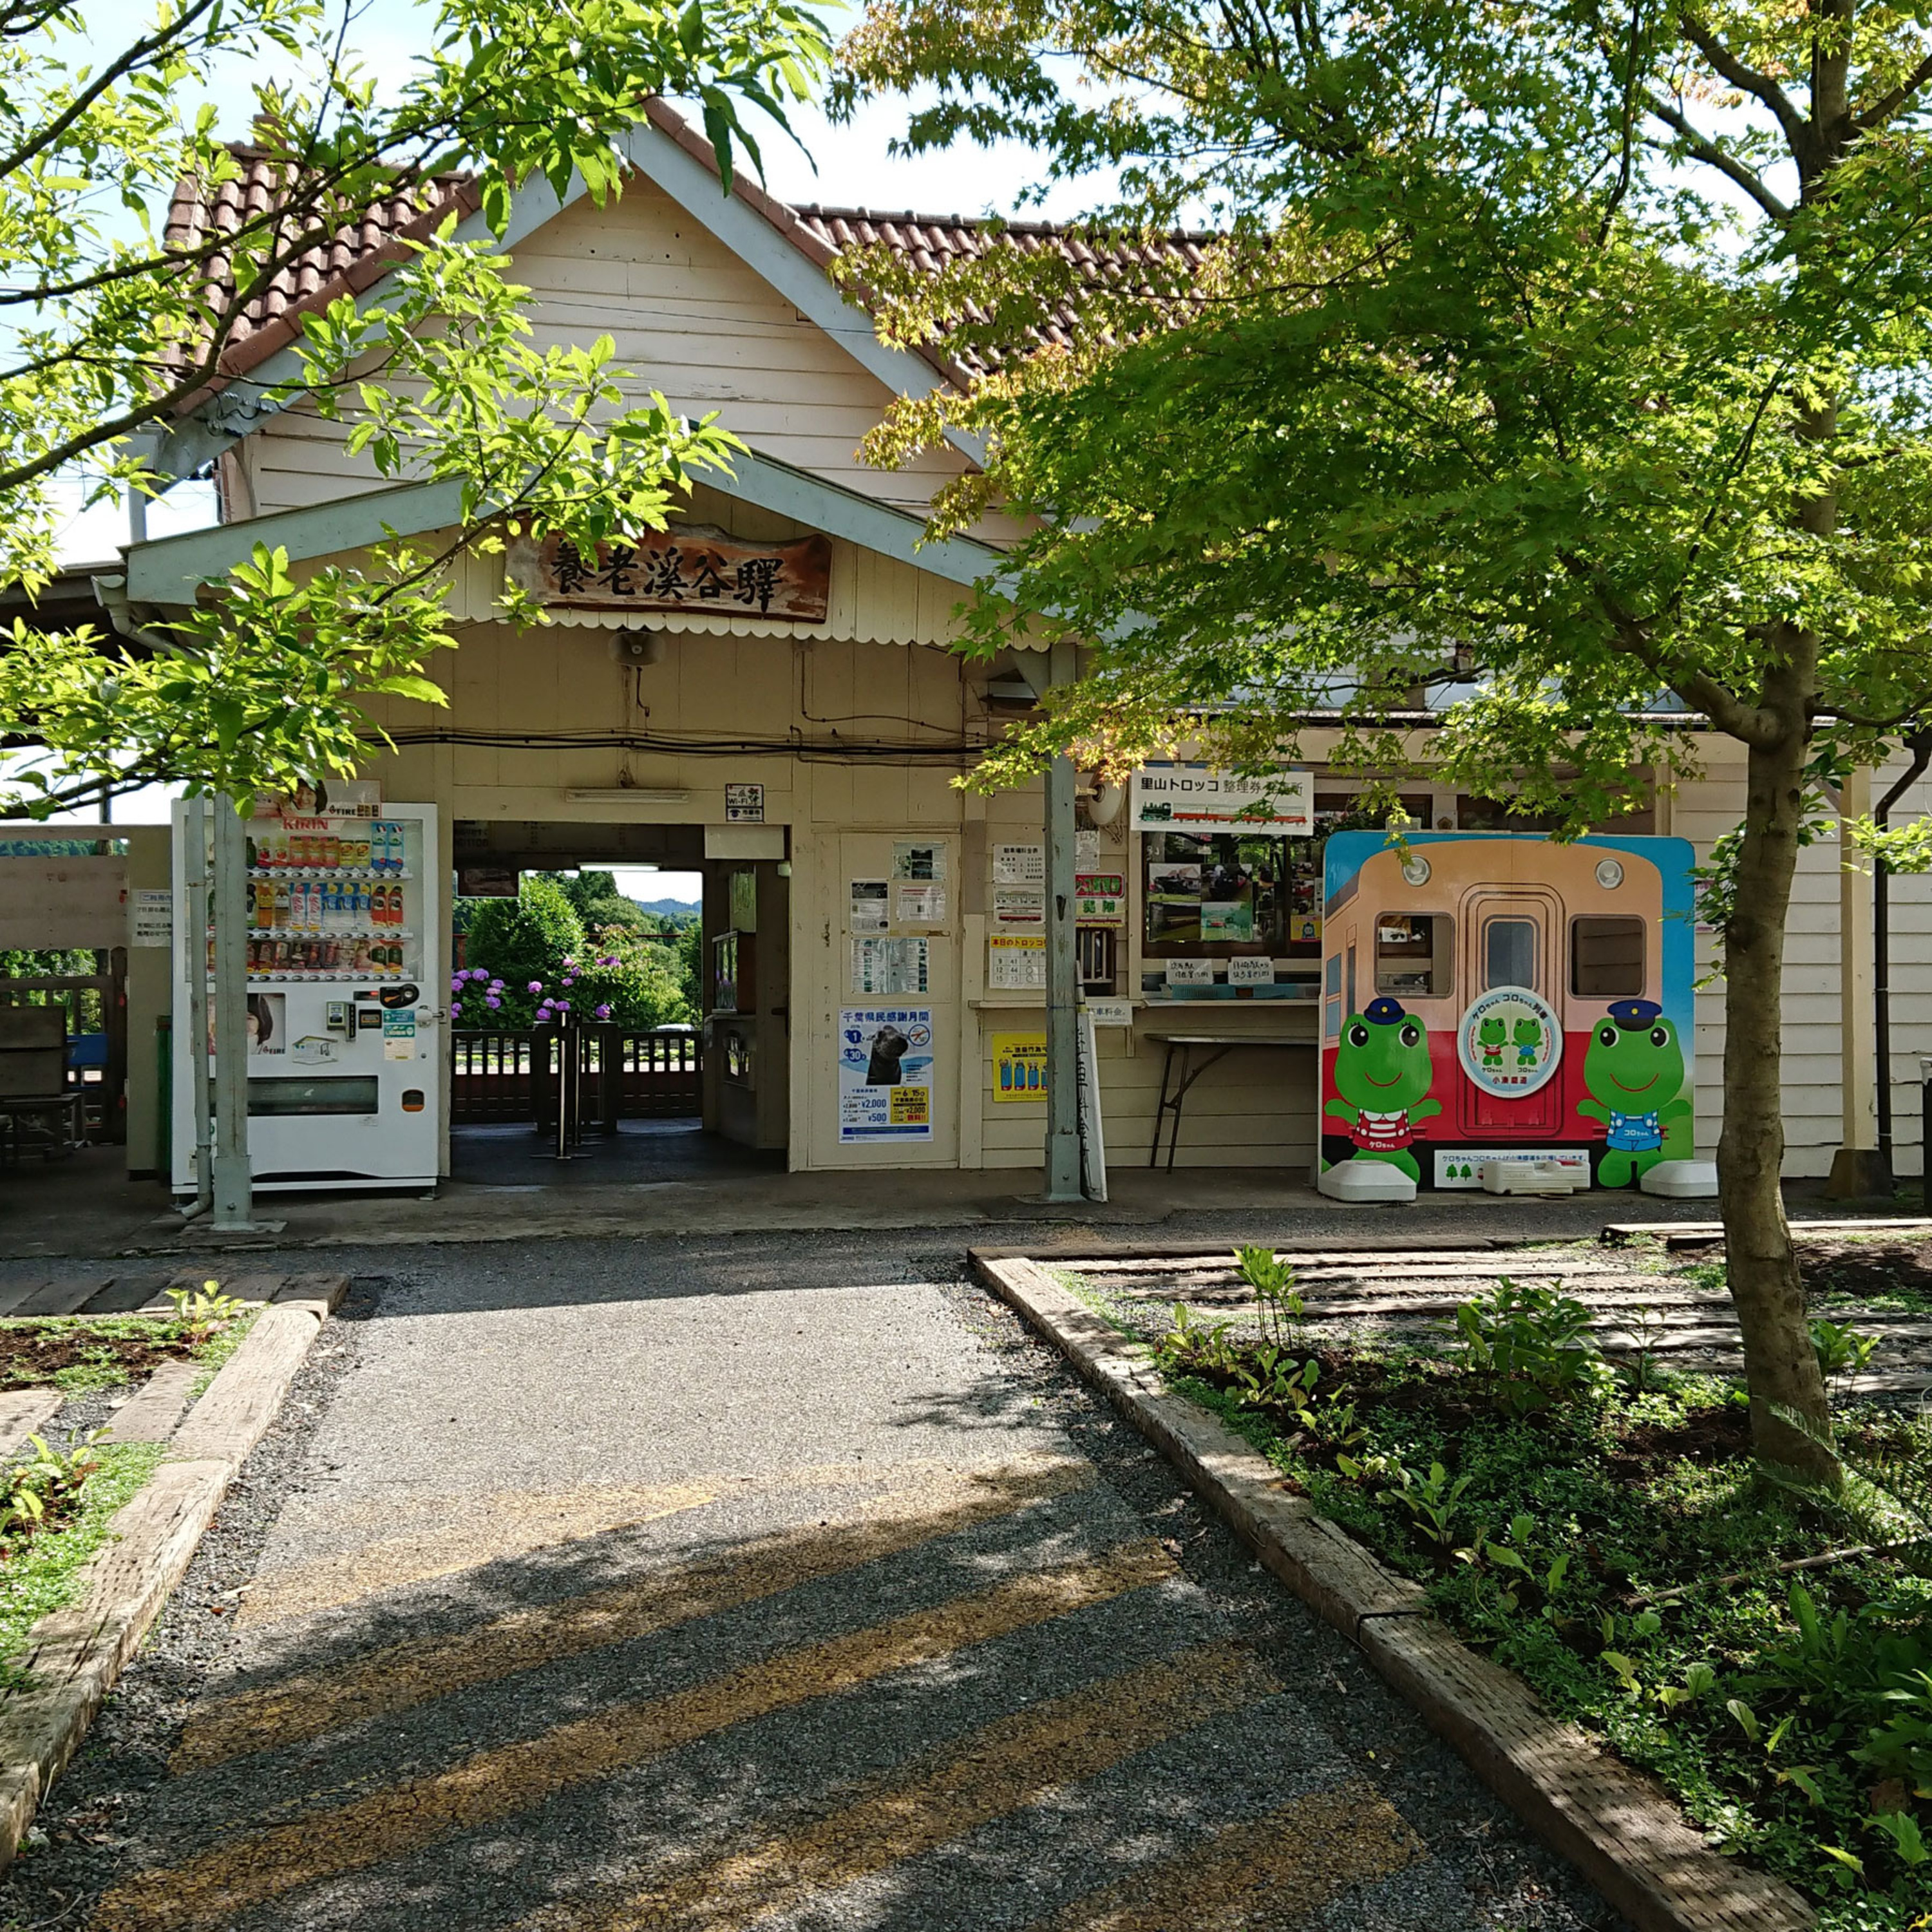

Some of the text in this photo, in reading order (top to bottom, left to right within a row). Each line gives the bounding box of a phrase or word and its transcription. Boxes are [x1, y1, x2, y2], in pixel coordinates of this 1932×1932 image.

[1141, 777, 1218, 791] 里山トロッコ
[283, 817, 328, 829] KIRIN
[843, 1011, 929, 1023] 千葉県民感謝月間
[849, 1050, 861, 1060] 30
